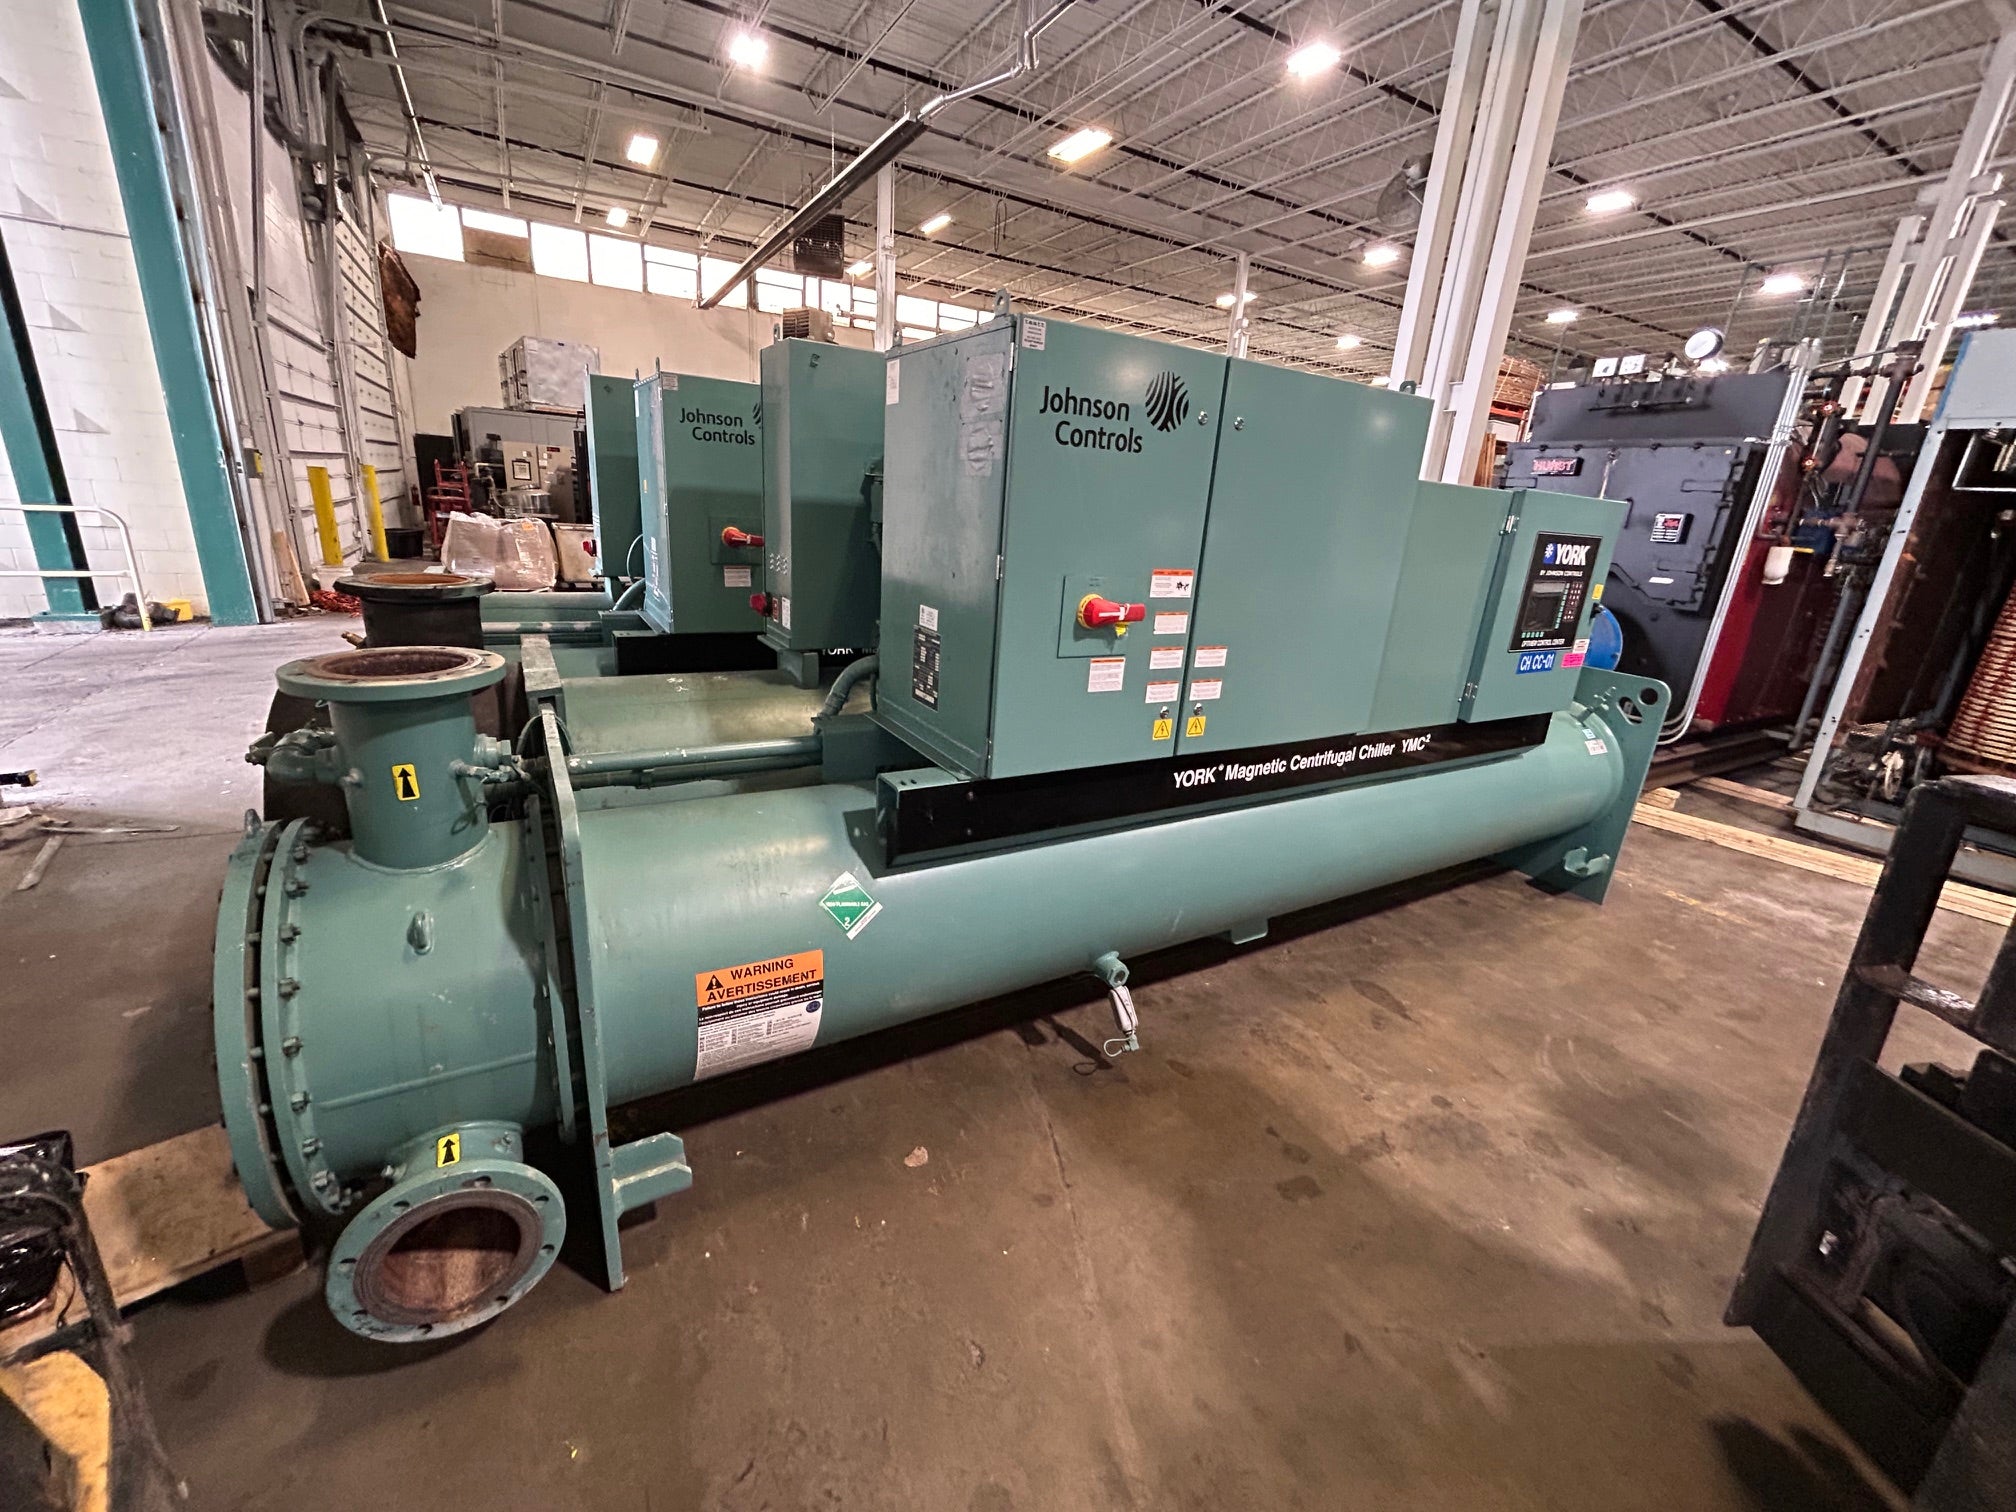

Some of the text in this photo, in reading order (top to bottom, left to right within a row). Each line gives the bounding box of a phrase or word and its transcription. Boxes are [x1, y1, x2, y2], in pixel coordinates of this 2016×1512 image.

[1039, 385, 1130, 422] Johnson
[680, 408, 743, 427] Johnson
[692, 426, 755, 446] Controls
[1055, 420, 1143, 454] Controls
[1555, 543, 1591, 566] YORK
[1520, 654, 1532, 671] CH
[1532, 653, 1555, 670] CC-01
[1224, 757, 1287, 782] Magnetic
[1289, 746, 1357, 770] Centrifugal
[1358, 742, 1395, 760] Chiller
[844, 916, 850, 926] 2
[731, 958, 794, 980] WARNING
[707, 969, 817, 1002] AVERTISSEMENT
